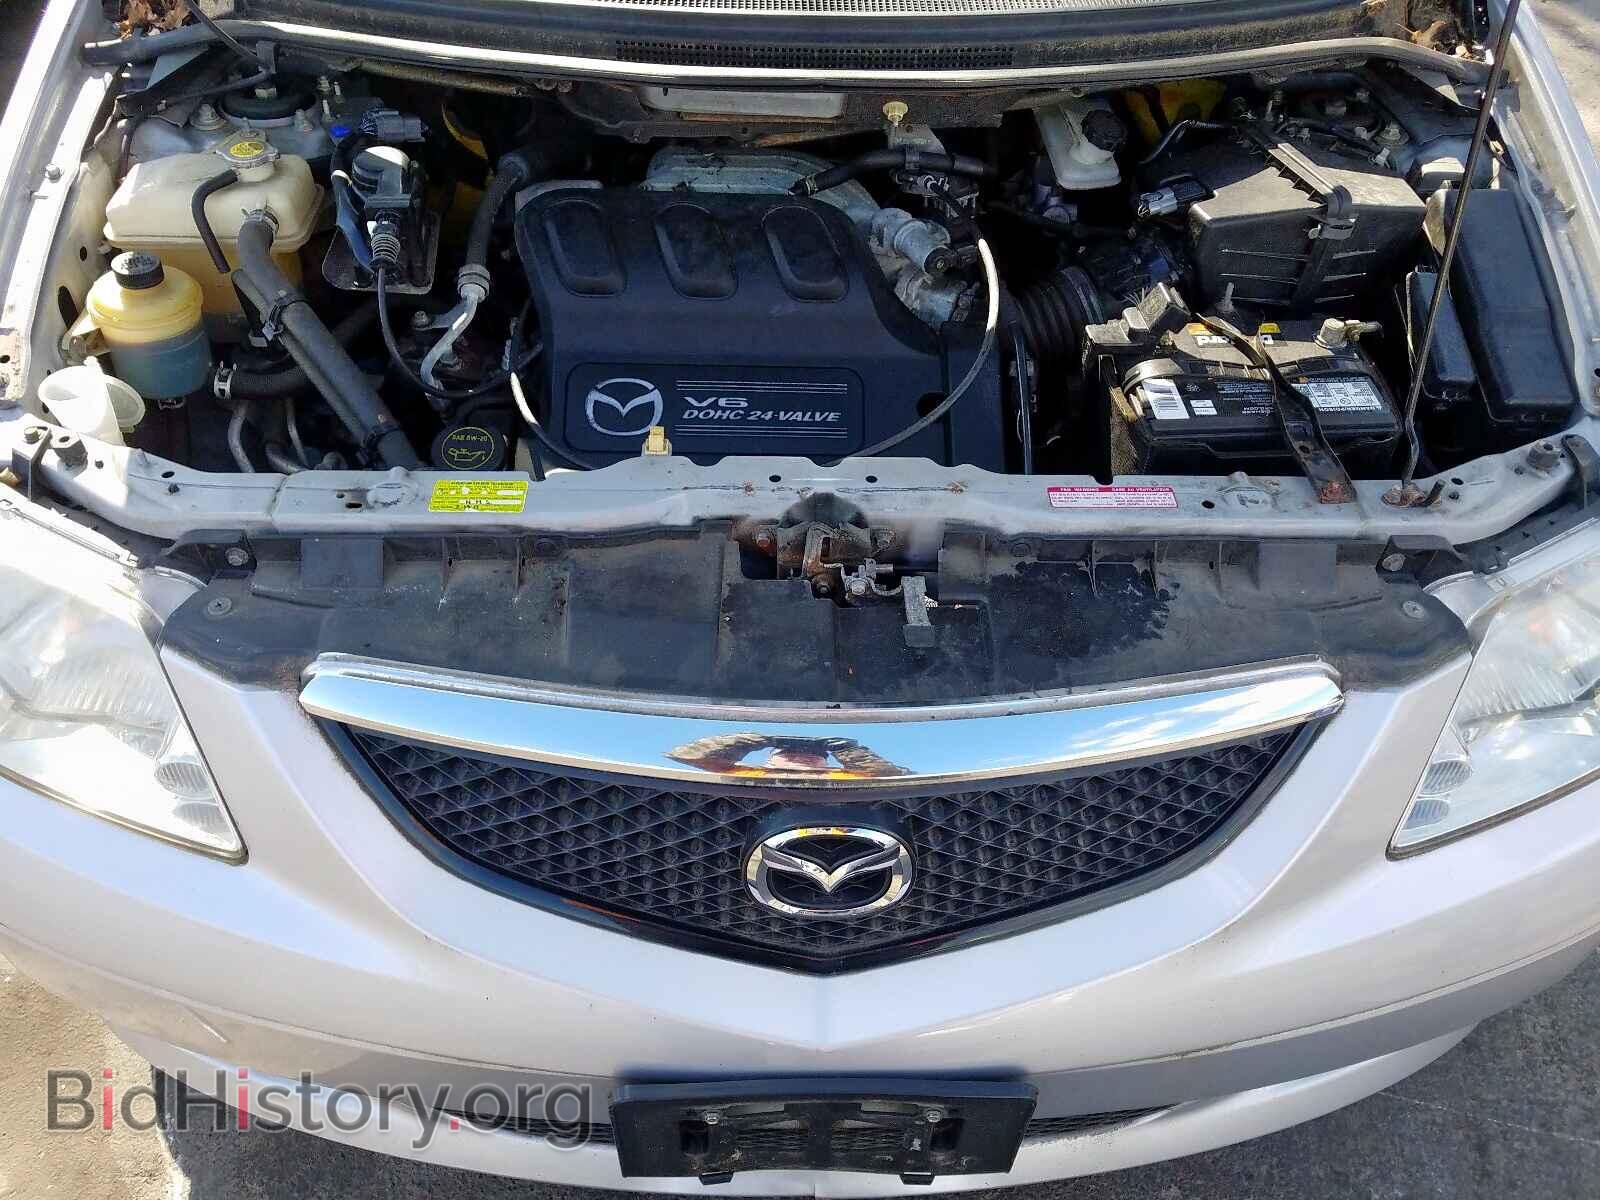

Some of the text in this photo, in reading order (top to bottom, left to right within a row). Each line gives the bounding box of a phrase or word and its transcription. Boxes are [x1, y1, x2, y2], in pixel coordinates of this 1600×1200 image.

[683, 396, 749, 408] V6
[682, 409, 842, 422] DOHC 24-VALVE
